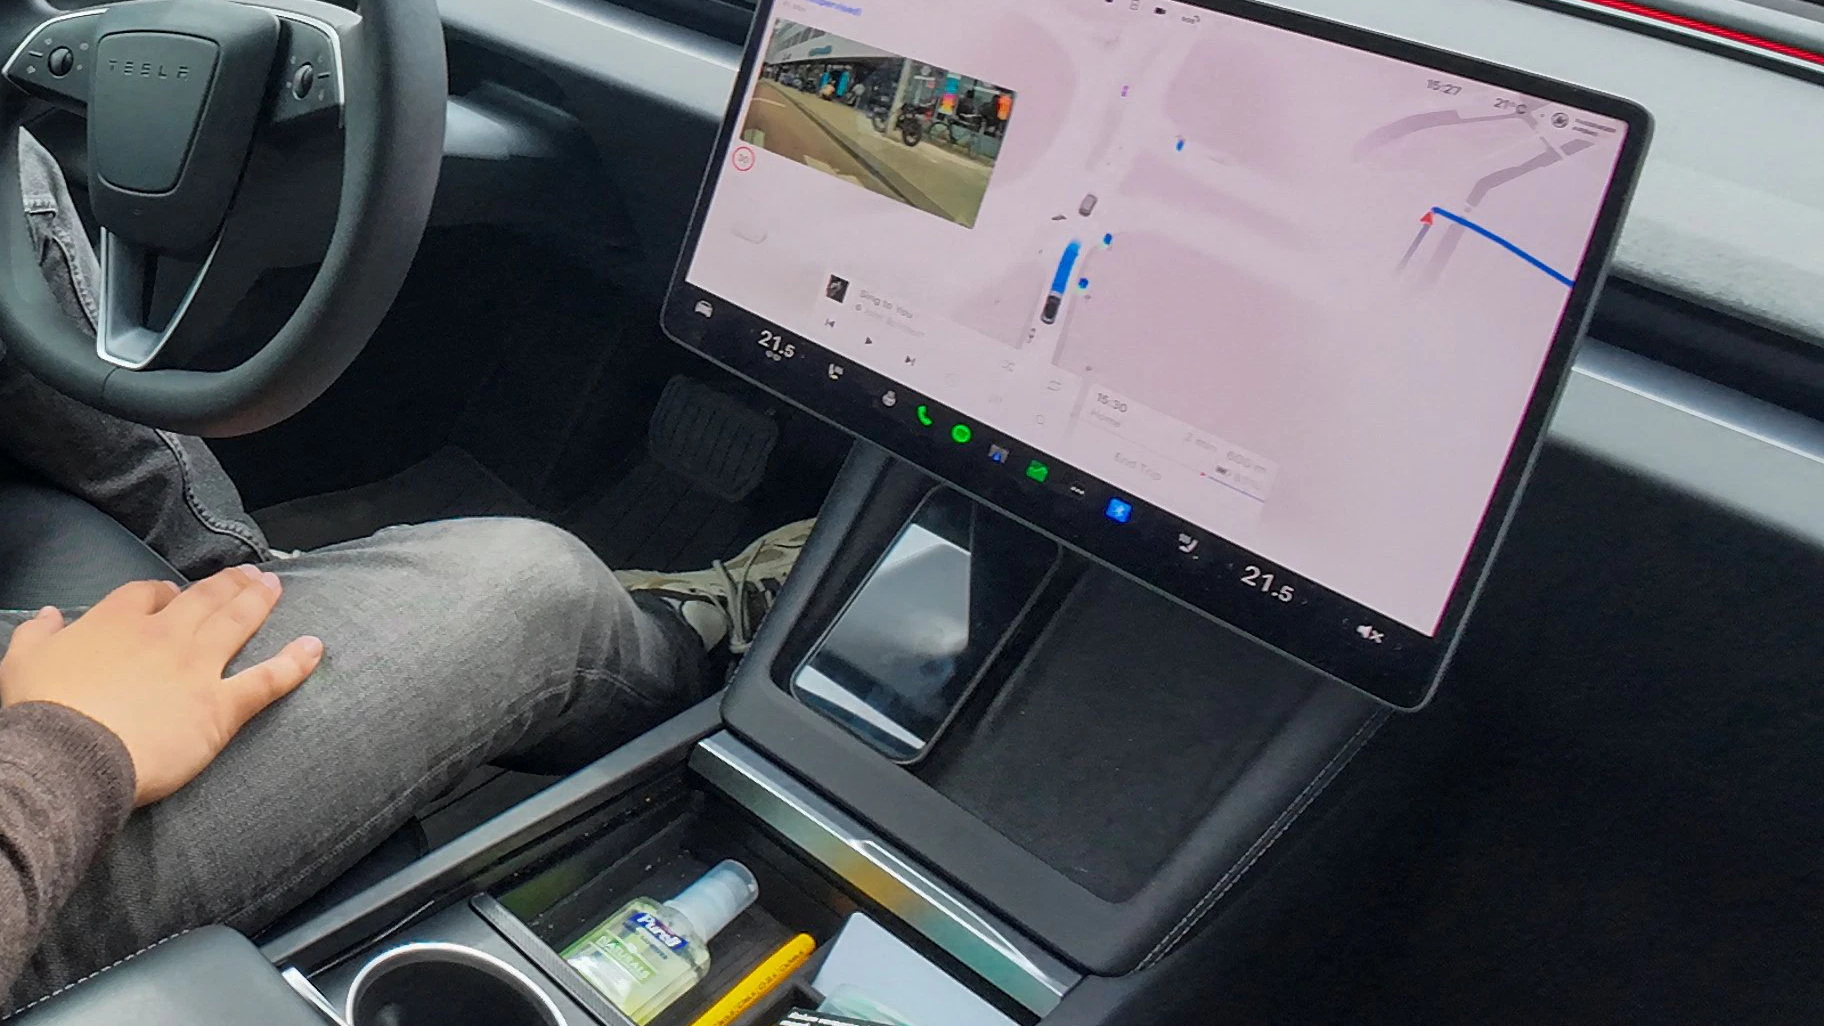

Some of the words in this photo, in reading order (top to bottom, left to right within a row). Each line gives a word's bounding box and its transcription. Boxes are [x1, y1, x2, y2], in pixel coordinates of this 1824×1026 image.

[108, 59, 190, 80] TESLA
[757, 329, 796, 358] 21.5
[1239, 565, 1295, 602] 21.5
